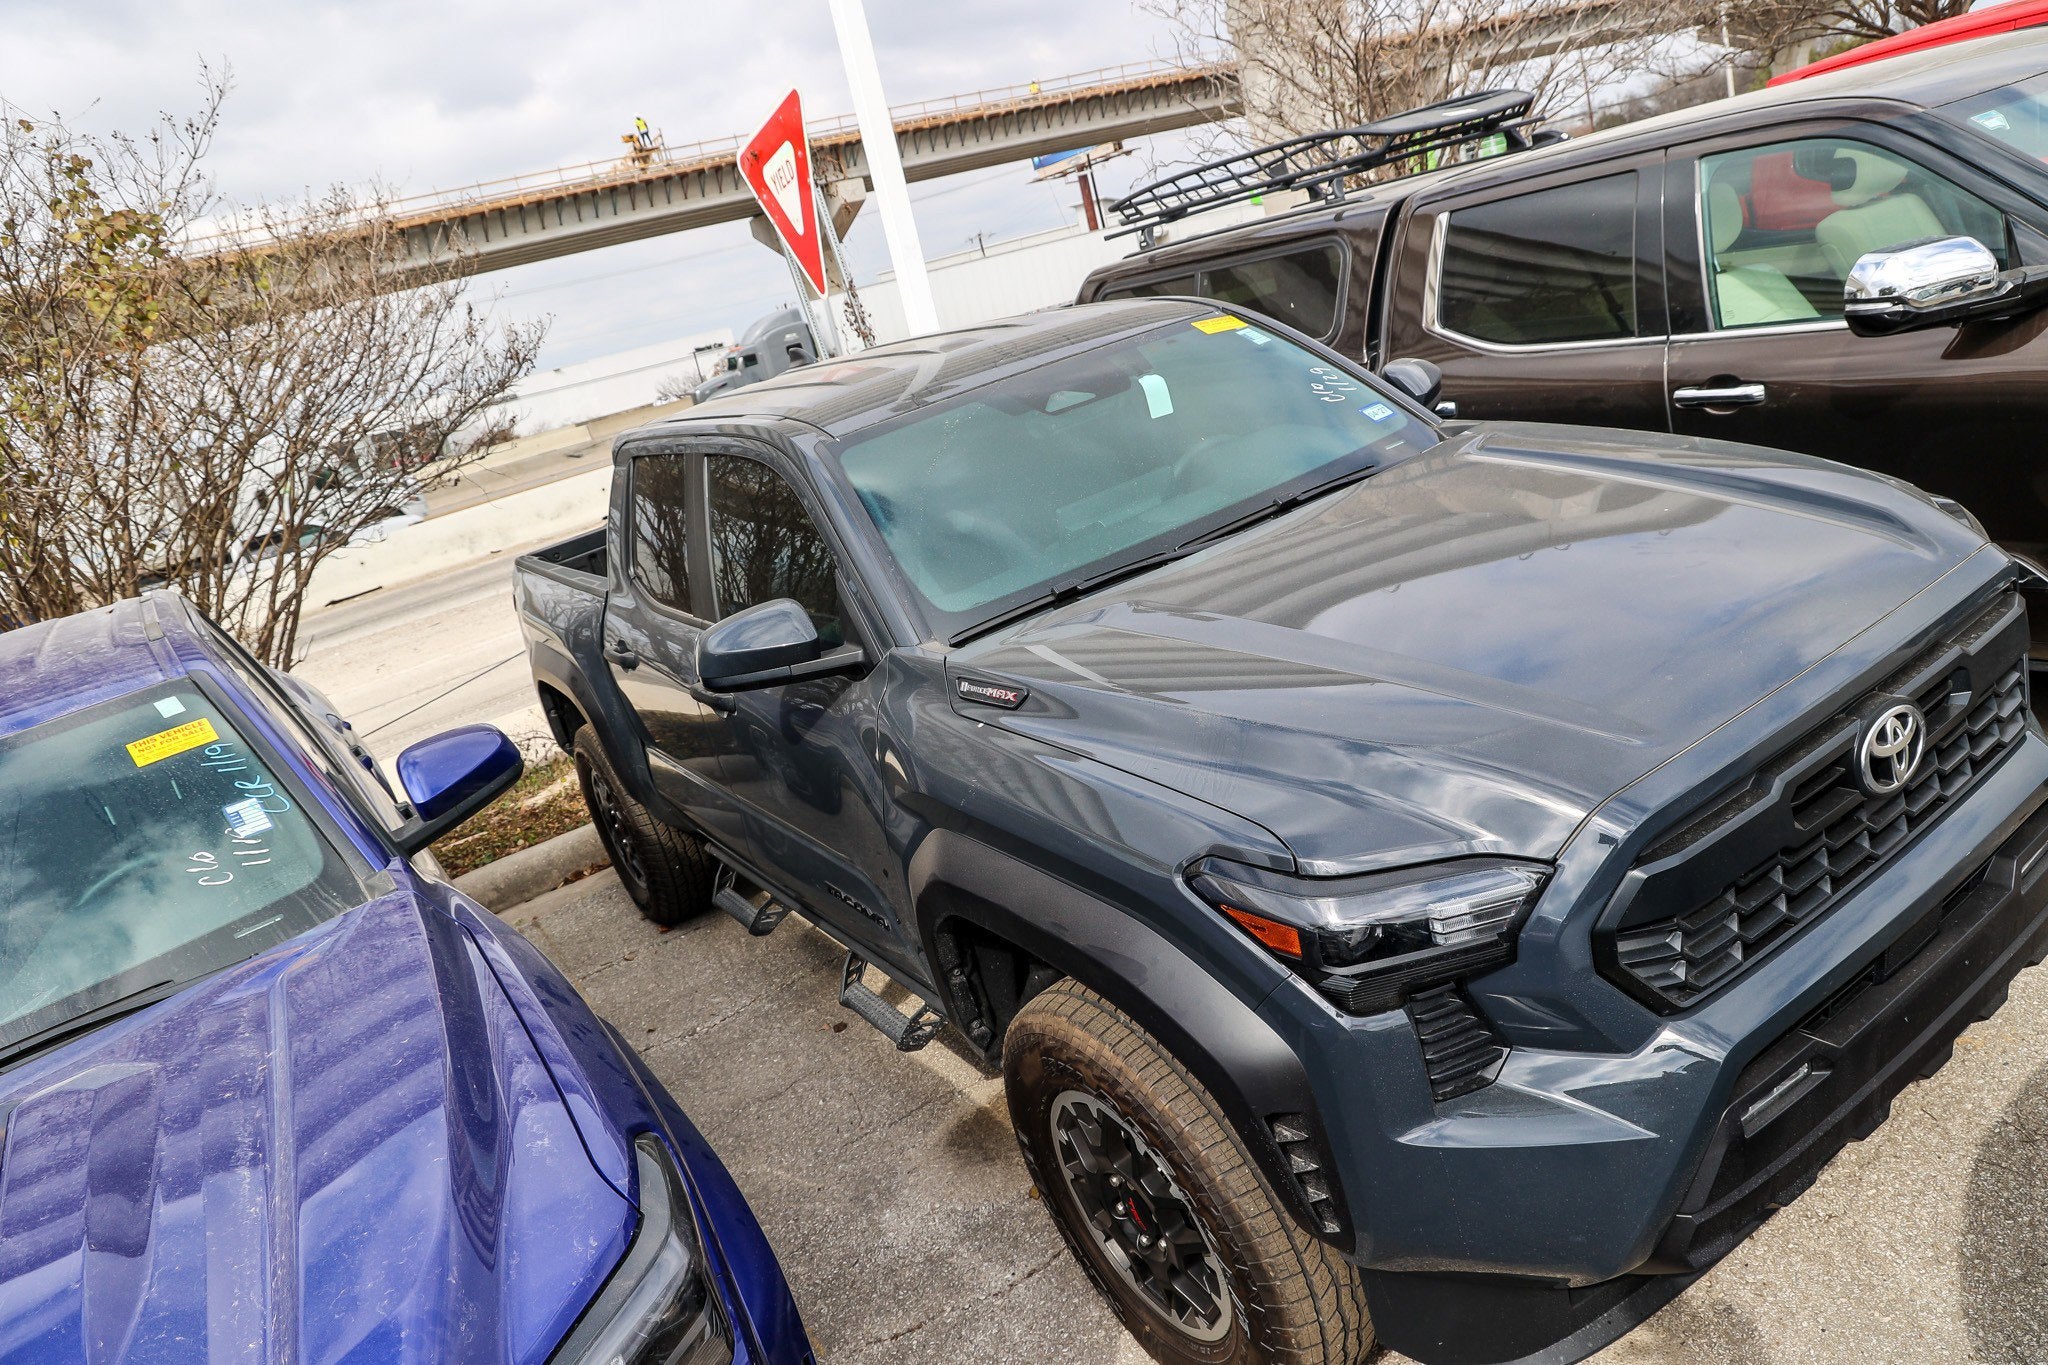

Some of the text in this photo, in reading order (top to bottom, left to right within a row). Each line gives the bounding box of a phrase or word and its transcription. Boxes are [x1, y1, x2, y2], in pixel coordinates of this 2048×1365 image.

[771, 160, 795, 195] YIELD
[131, 737, 158, 750] THIS
[159, 720, 206, 740] VEHICLE
[136, 743, 157, 754] NOT
[159, 735, 180, 746] FOR
